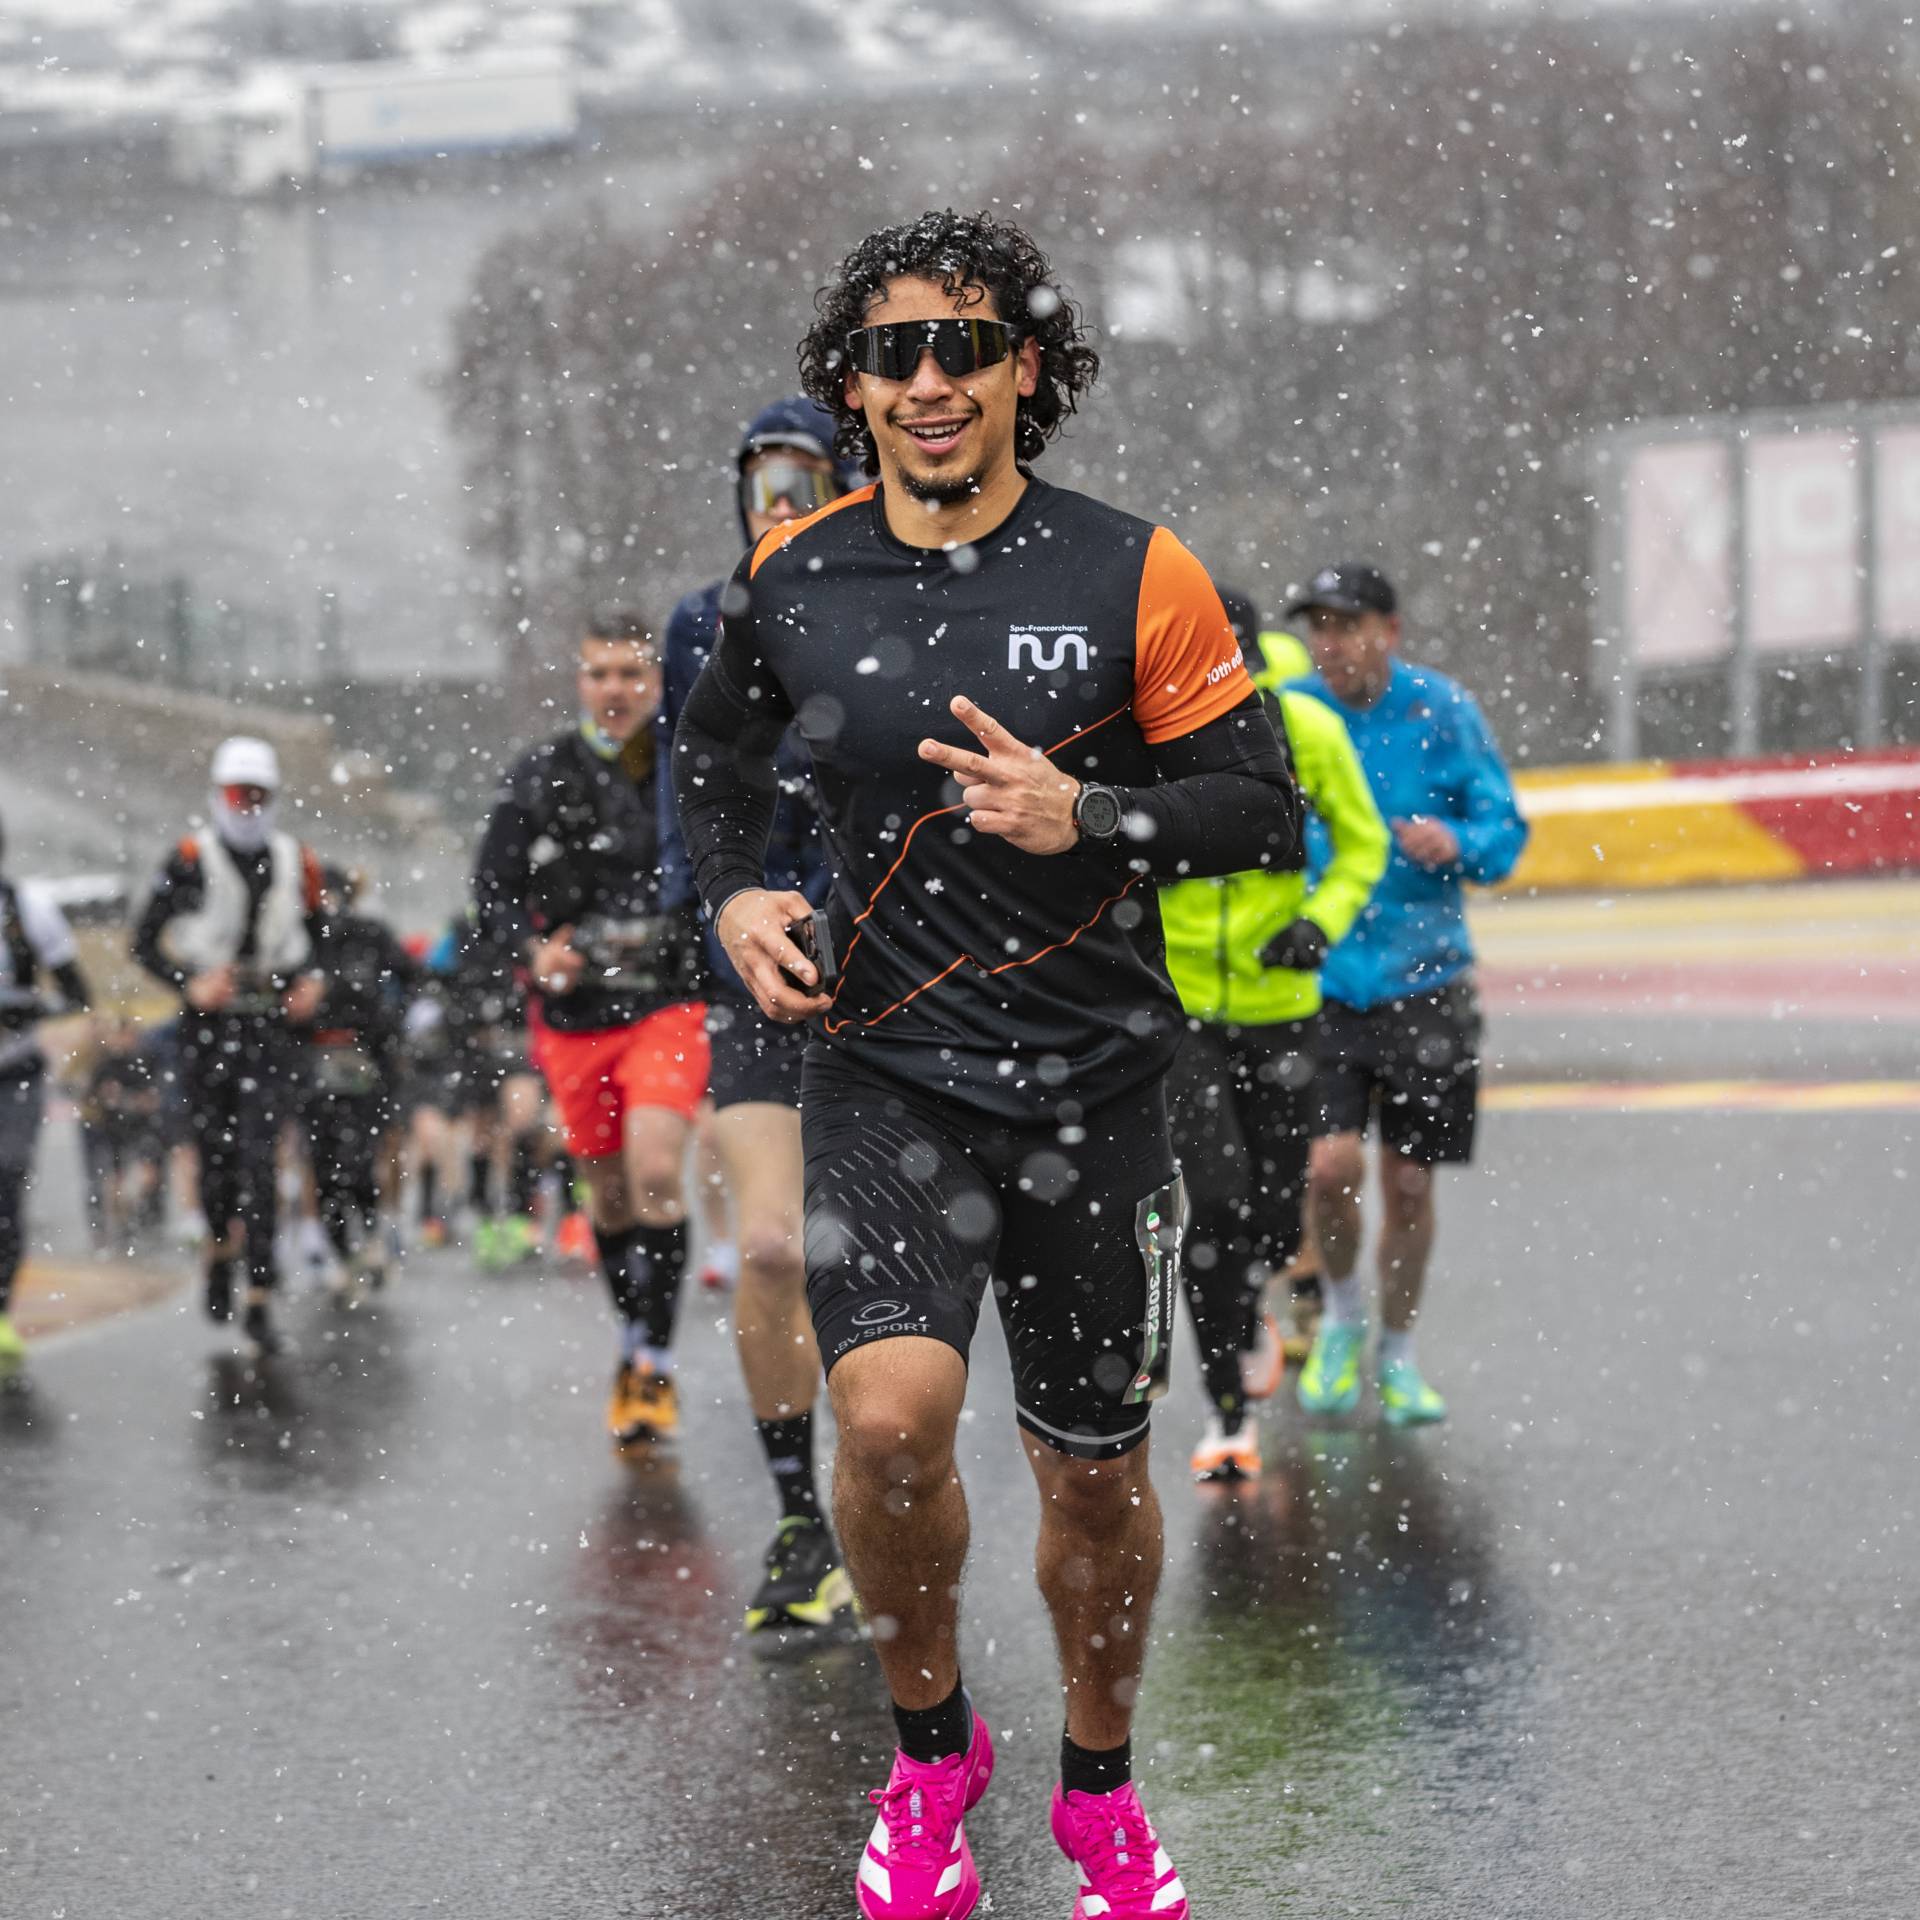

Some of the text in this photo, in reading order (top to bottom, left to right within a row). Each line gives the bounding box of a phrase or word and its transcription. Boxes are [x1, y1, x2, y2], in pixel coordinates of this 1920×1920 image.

[1009, 624, 1088, 632] Spa-Francorchamps
[1206, 661, 1232, 686] 10th
[1147, 1273, 1161, 1337] 3082
[838, 1322, 931, 1351] BV SPORT
